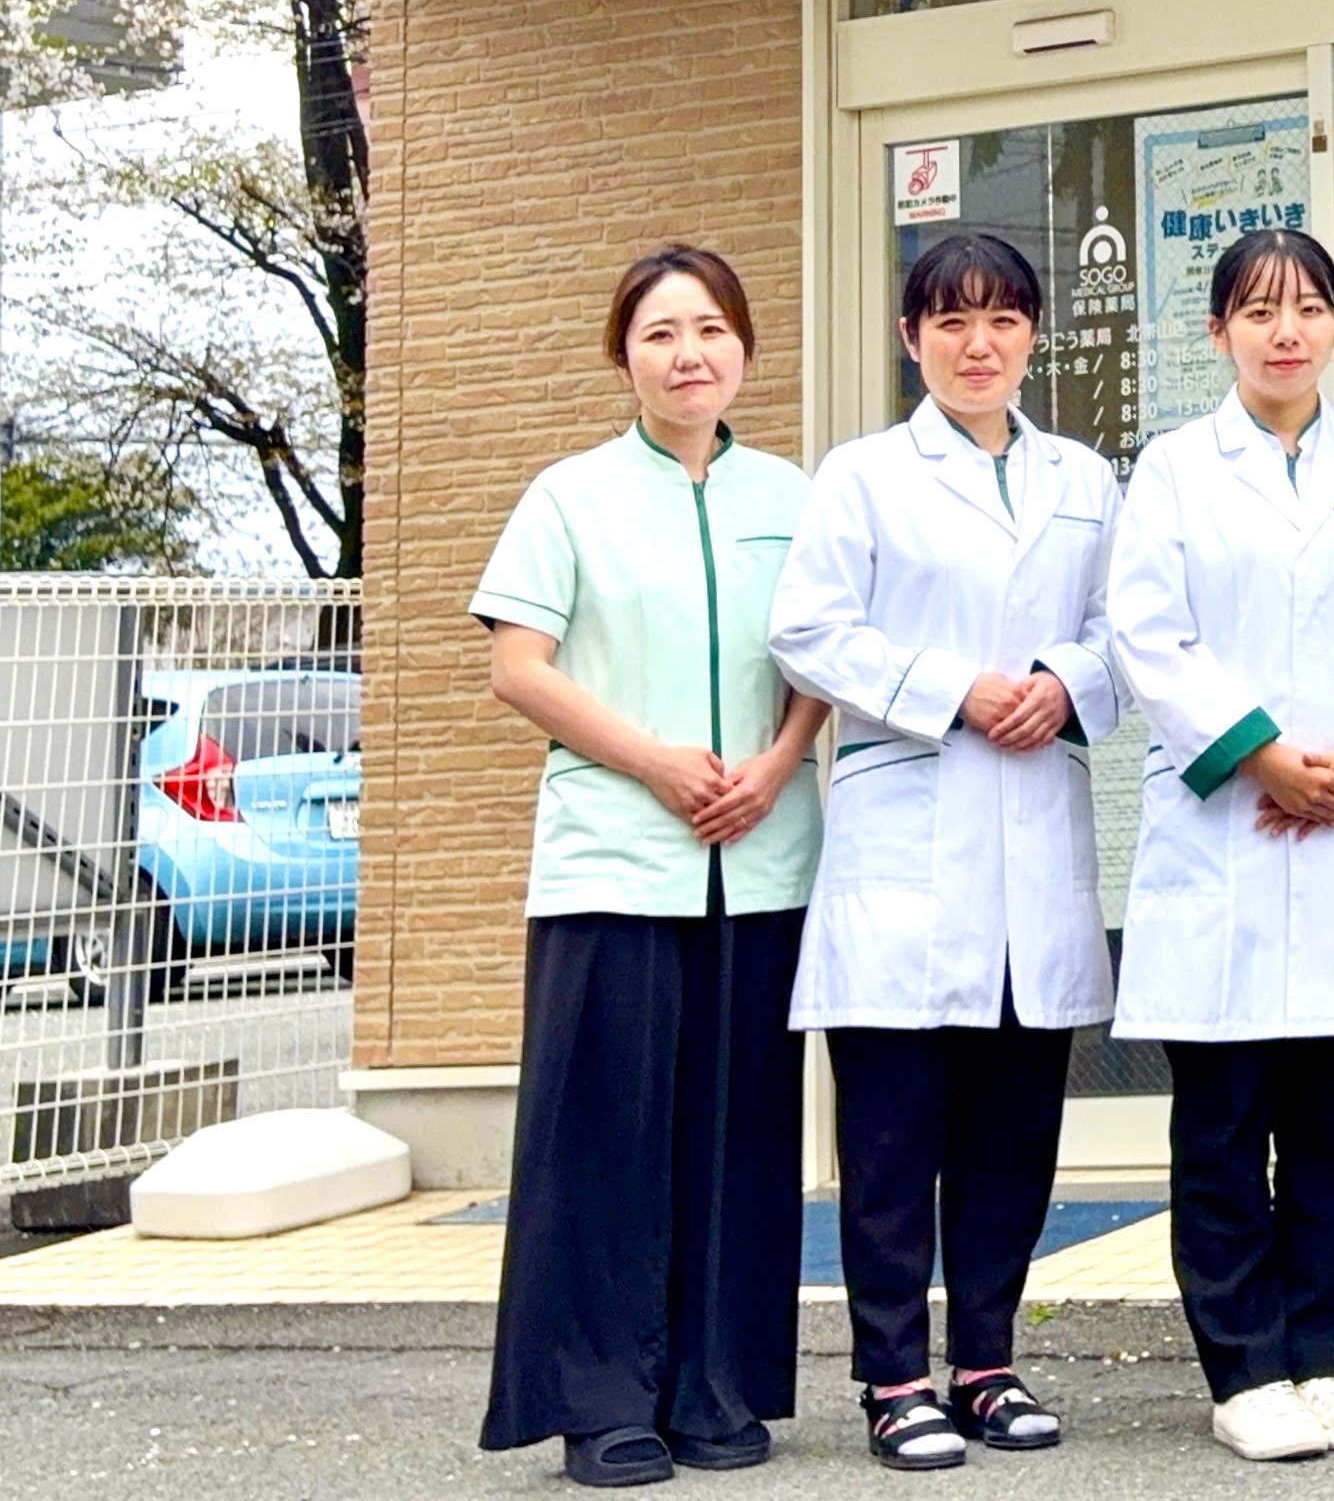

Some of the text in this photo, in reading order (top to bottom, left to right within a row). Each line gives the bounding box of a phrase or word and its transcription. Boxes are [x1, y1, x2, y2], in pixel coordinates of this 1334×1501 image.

[1161, 202, 1306, 242] 健康いきいき
[1079, 265, 1127, 287] SOGO
[1072, 294, 1136, 318] 保険薬局
[1037, 326, 1112, 354] うごう薬局
